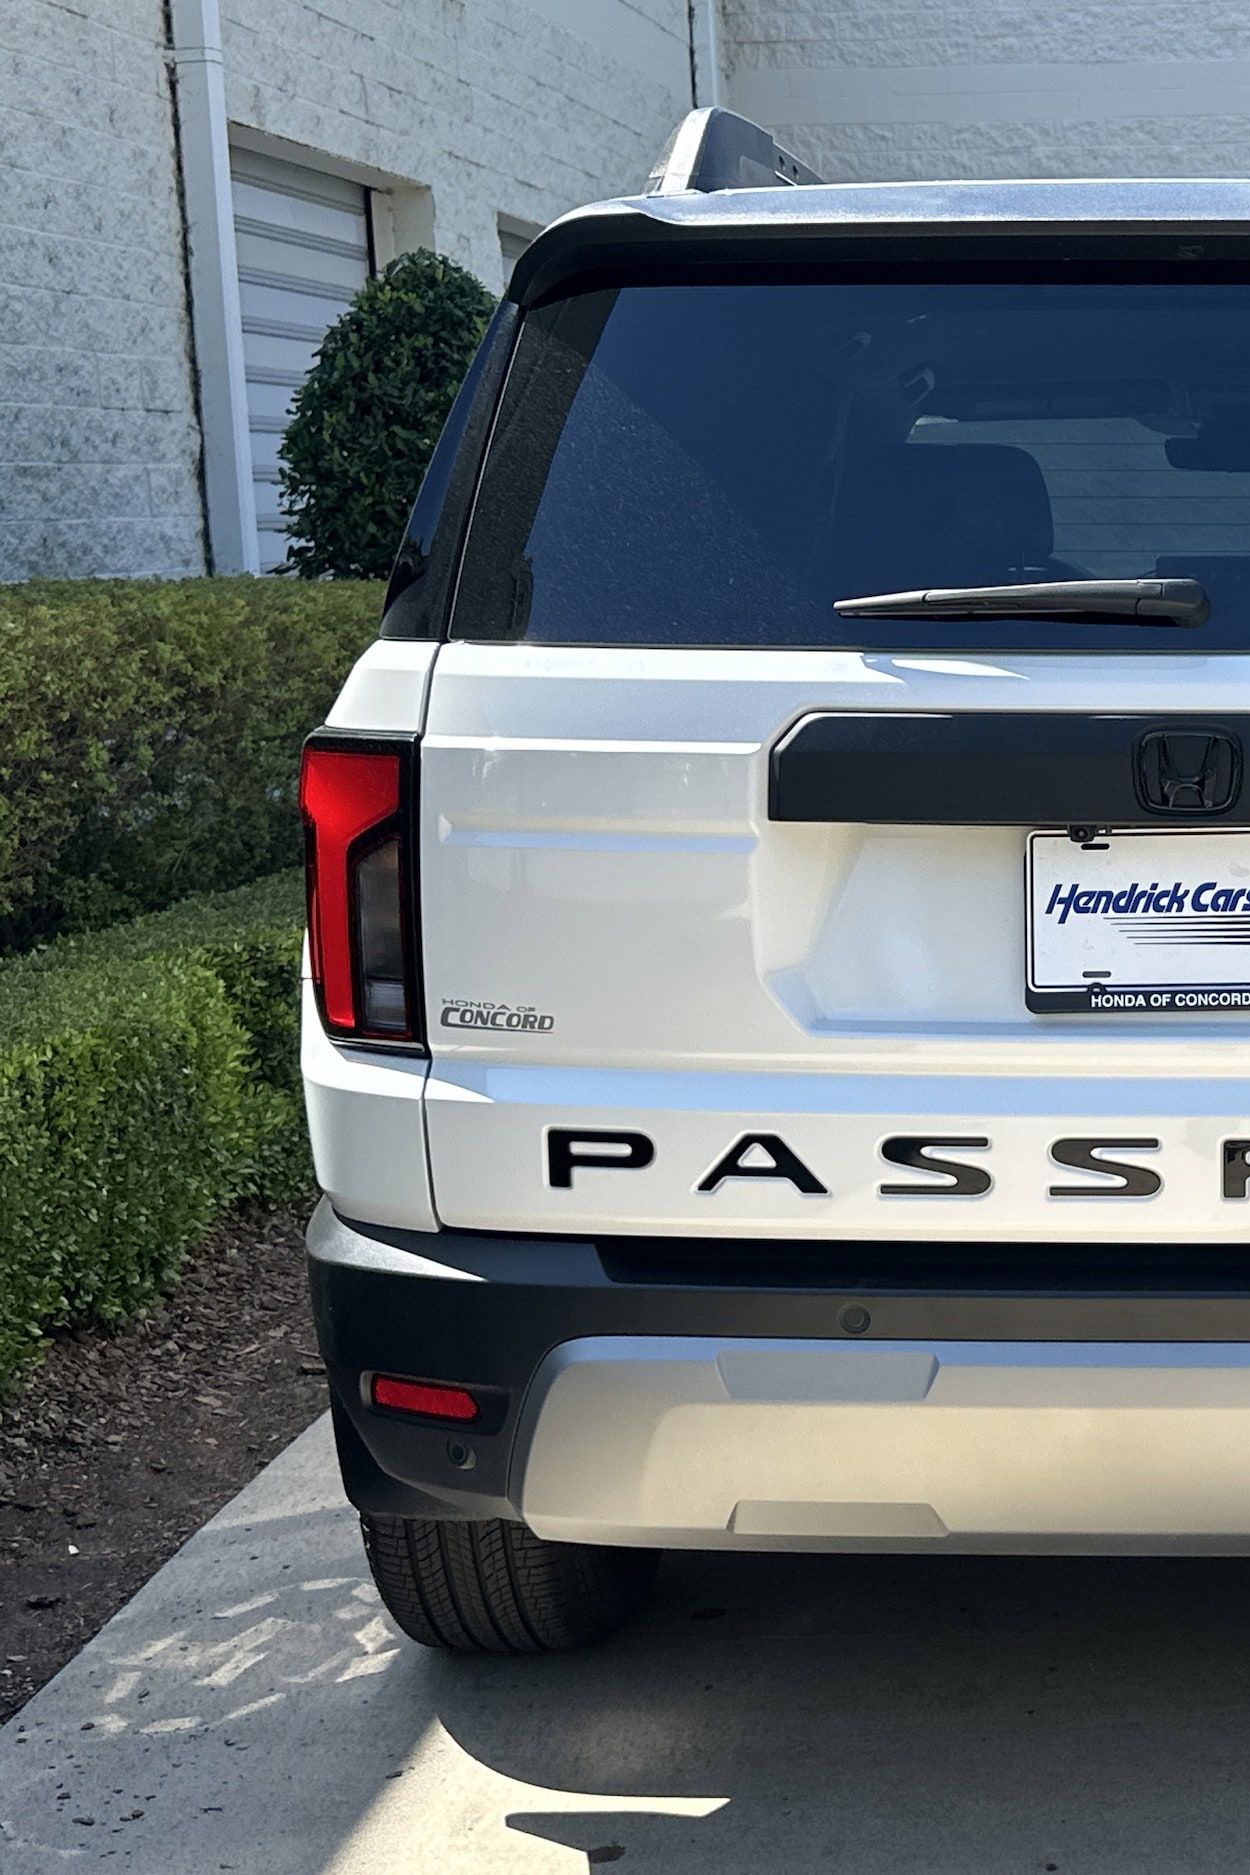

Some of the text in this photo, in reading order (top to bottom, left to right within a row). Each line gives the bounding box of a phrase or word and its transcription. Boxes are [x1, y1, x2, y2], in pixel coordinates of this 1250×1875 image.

[441, 998, 511, 1012] HONDA
[1091, 994, 1146, 1008] HONDA
[1150, 993, 1171, 1006] OF
[440, 1006, 554, 1031] CONCORD
